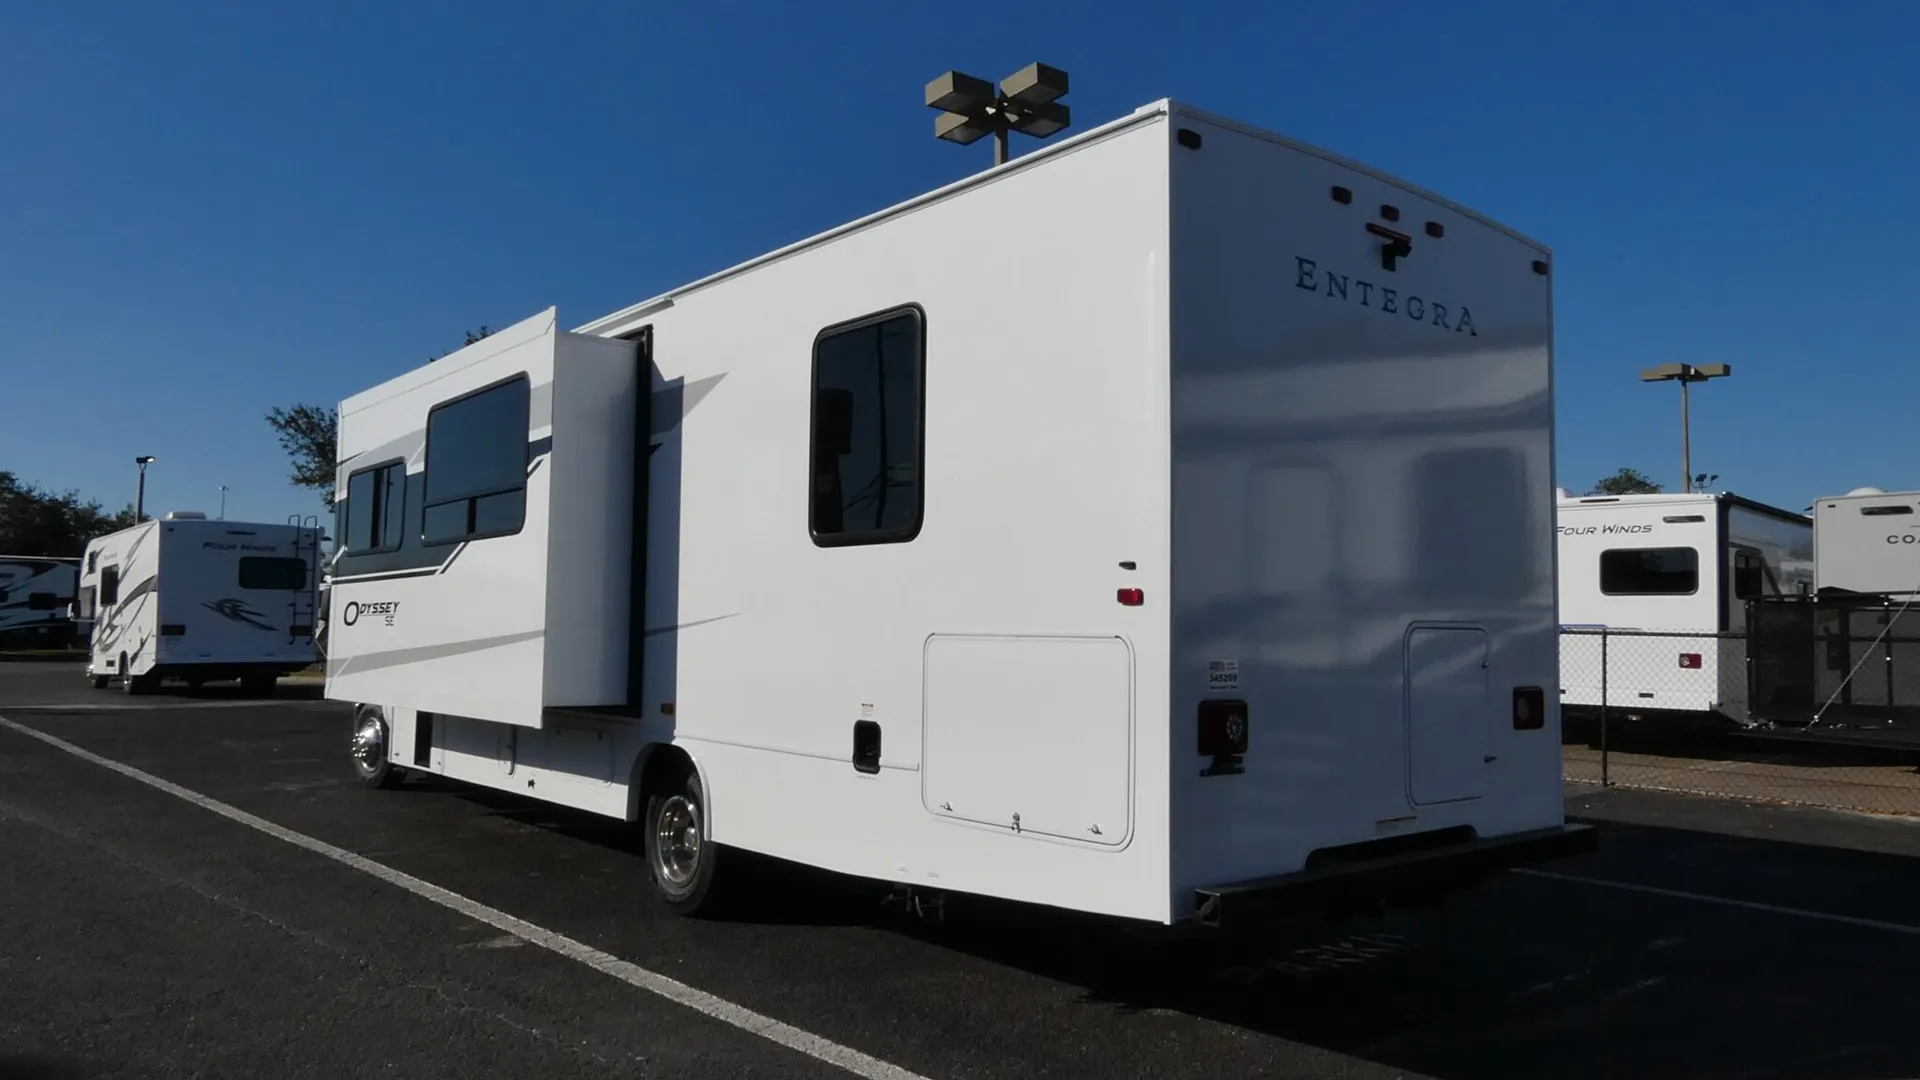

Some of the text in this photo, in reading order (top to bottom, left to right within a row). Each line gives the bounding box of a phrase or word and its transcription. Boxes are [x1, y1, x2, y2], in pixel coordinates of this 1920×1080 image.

[1295, 255, 1478, 337] ENTEGRA
[1602, 524, 1653, 535] WINDS
[1886, 534, 1920, 544] CO
[343, 601, 400, 626] ODYSSEY
[385, 616, 394, 626] SE
